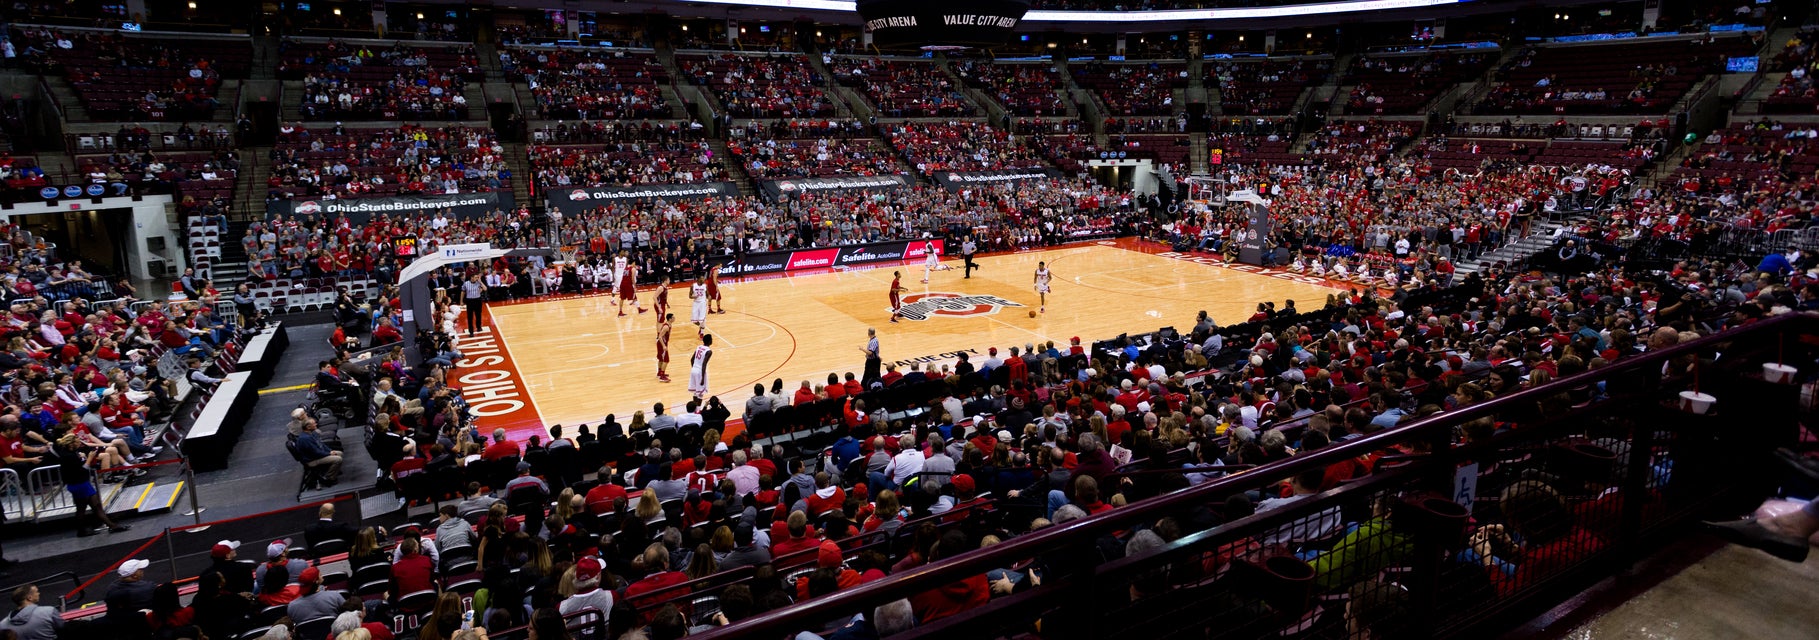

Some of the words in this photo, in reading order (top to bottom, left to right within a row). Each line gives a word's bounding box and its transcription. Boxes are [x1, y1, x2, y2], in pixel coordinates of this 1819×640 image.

[888, 15, 918, 28] ARENA
[943, 14, 976, 26] VALUE
[977, 15, 999, 26] CITY
[799, 180, 899, 190] OhioStateBuckeyes.com
[593, 187, 718, 199] OhioStateBuckeyes.com
[327, 198, 487, 213] OhioStateBuckeyes.com
[793, 258, 829, 267] safelite.com
[842, 251, 876, 263] Safelite
[755, 263, 783, 271] AutoGlass
[459, 369, 525, 417] OHIO
